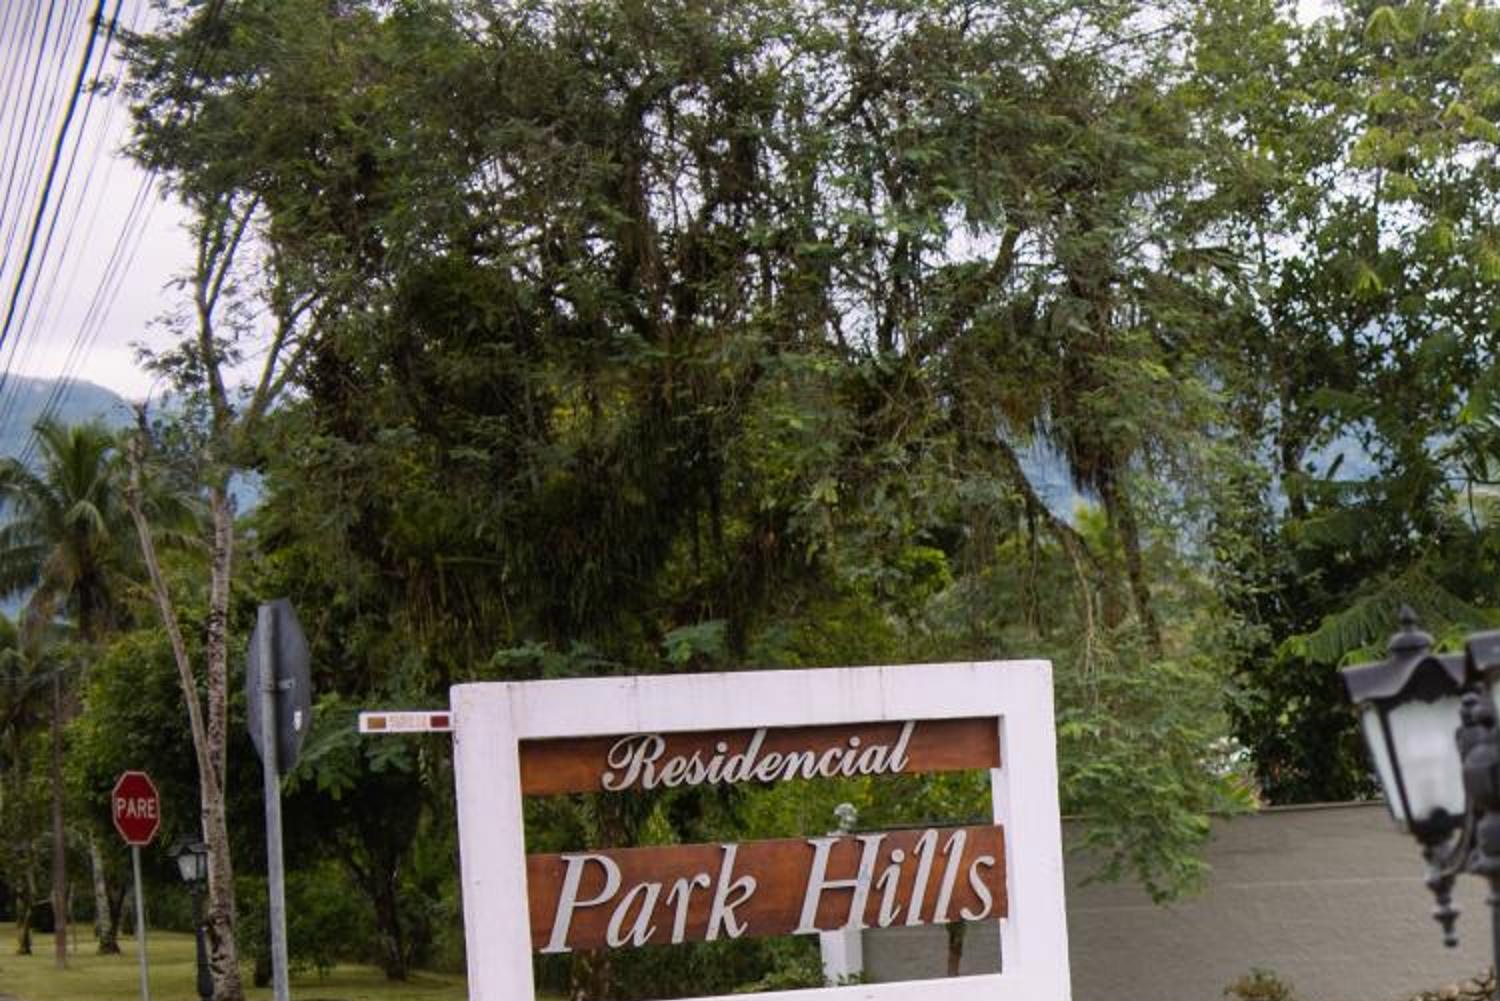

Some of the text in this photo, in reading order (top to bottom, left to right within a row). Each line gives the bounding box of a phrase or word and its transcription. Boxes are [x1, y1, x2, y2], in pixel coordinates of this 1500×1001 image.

[602, 720, 915, 791] Residencial
[117, 798, 157, 819] PARE
[539, 828, 996, 953] Park Hills
